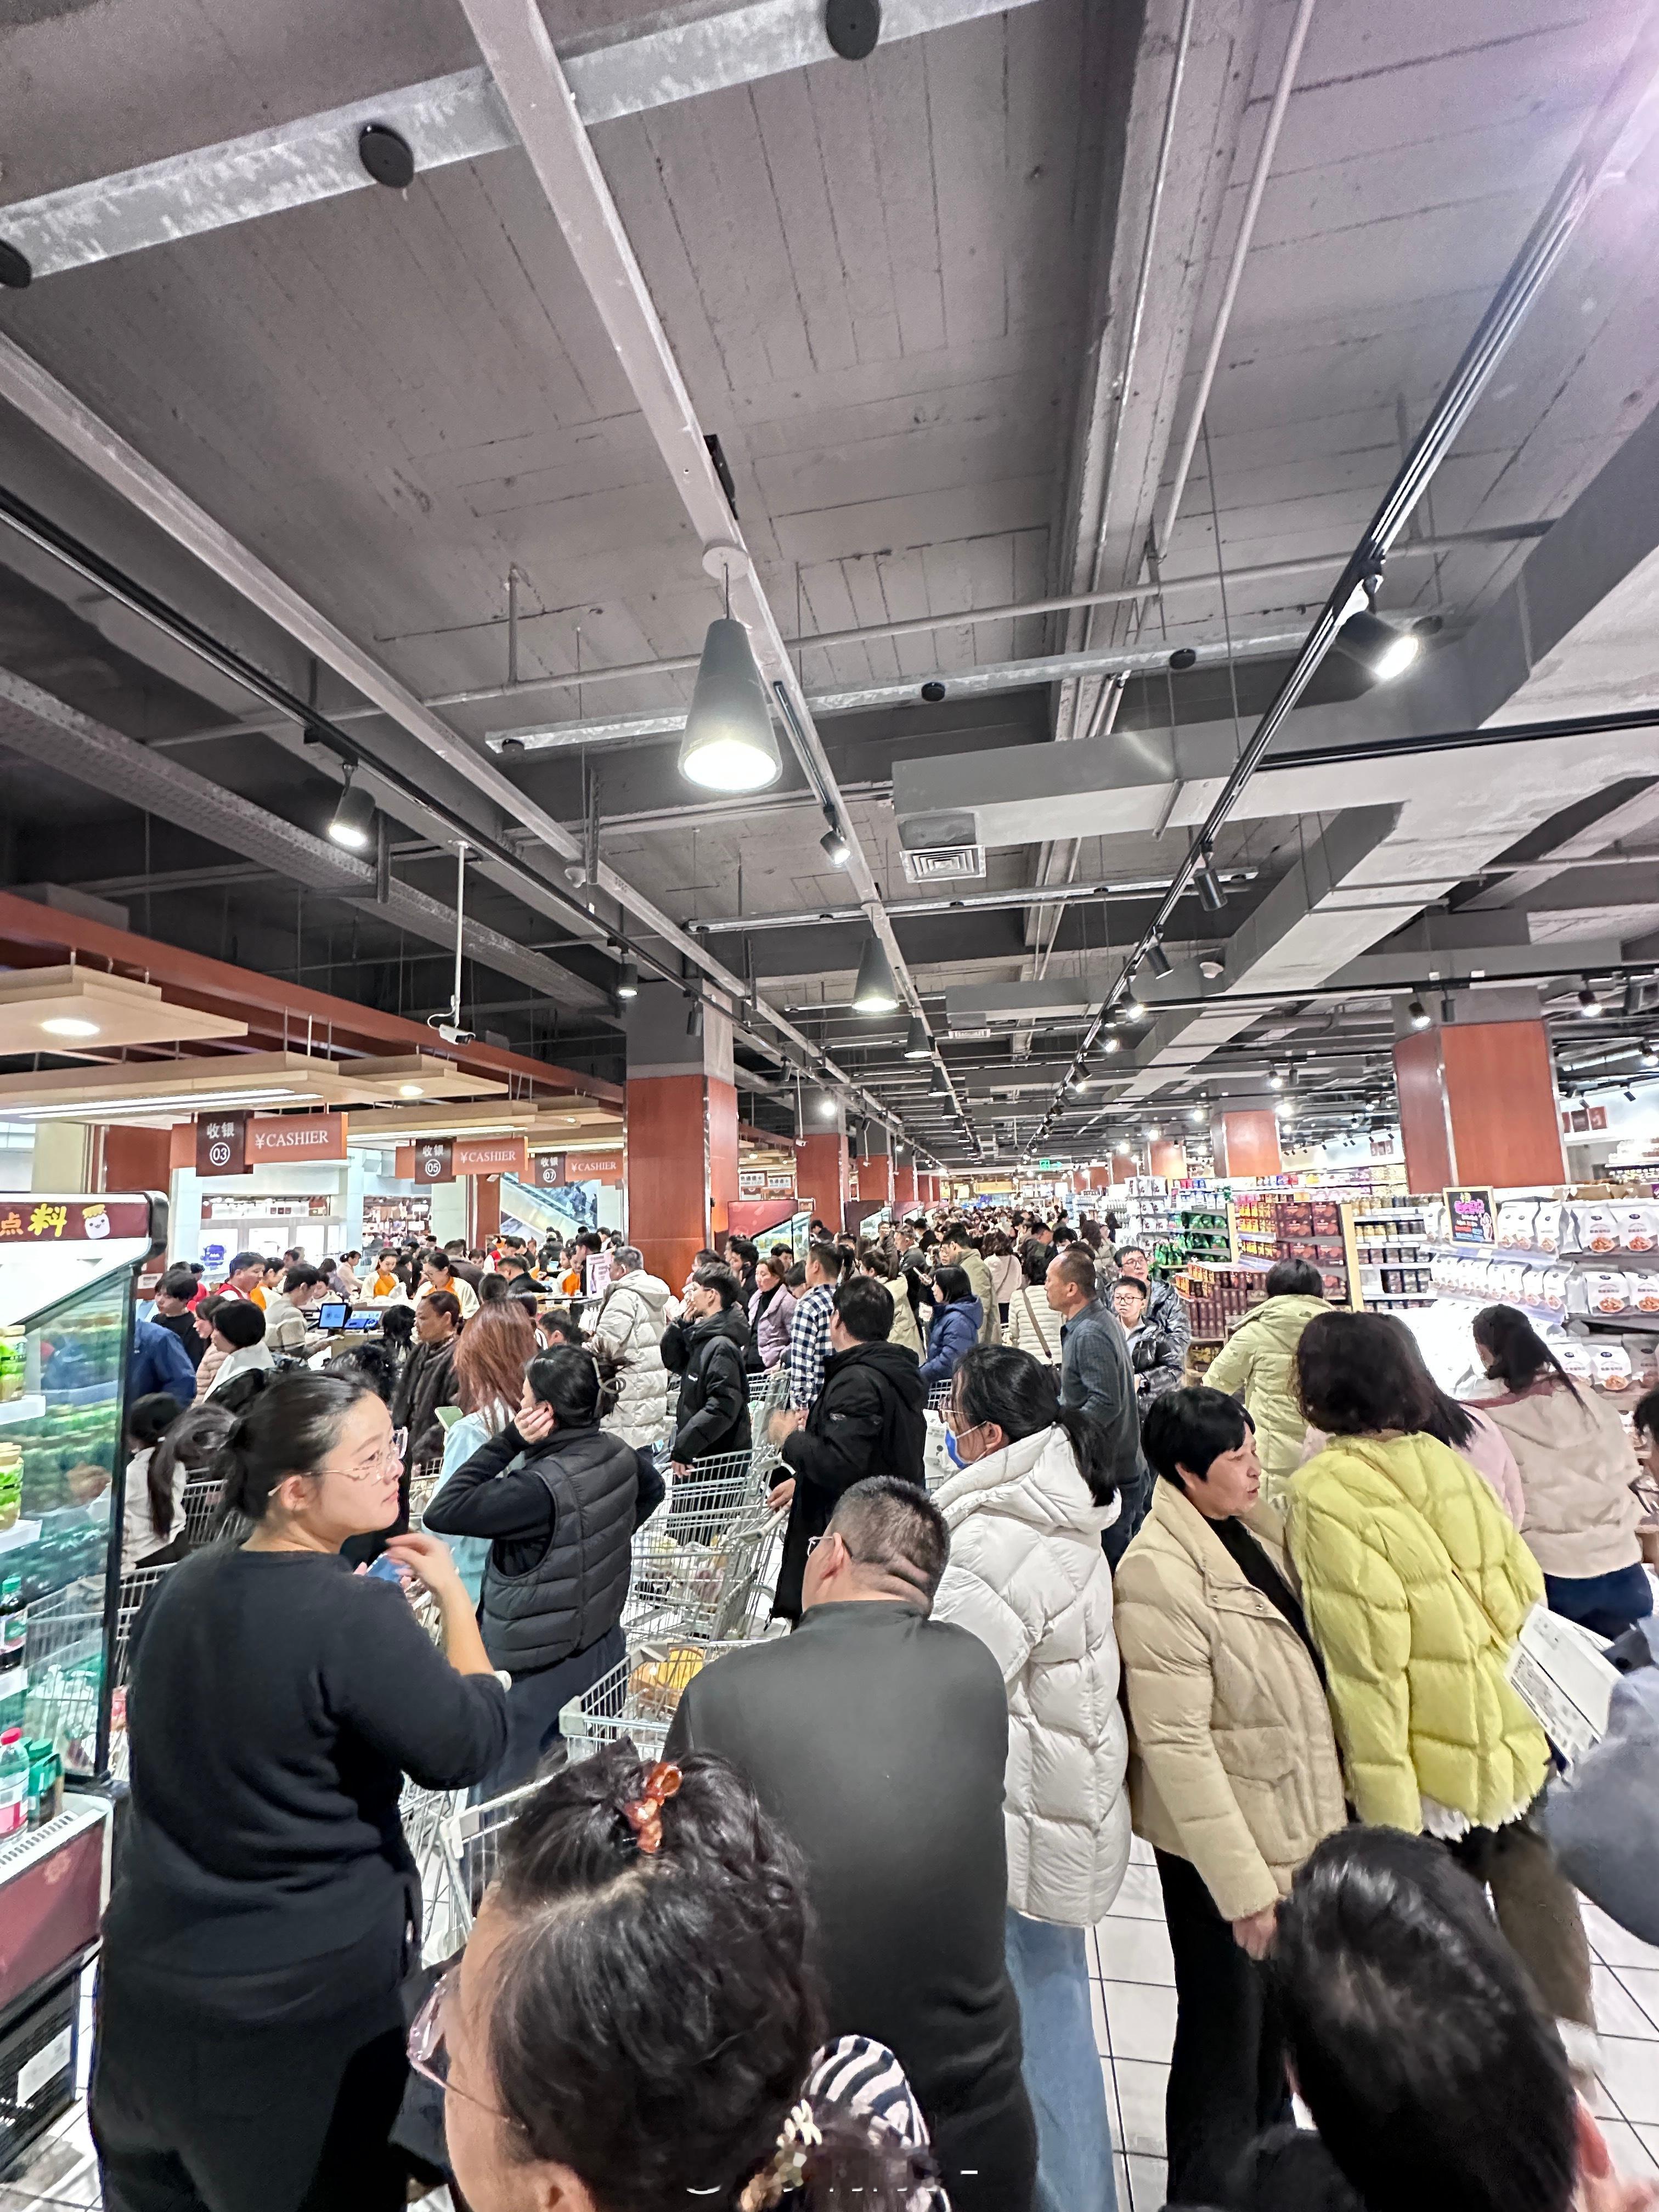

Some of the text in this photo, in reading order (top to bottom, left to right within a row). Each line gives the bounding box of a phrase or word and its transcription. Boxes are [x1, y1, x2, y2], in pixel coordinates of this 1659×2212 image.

[206, 1122, 235, 1139] 收银
[212, 1147, 227, 1161] 03
[422, 1144, 444, 1157] 收银
[540, 1156, 558, 1167] 收银
[427, 1163, 439, 1173] 05
[545, 1171, 555, 1180] 07
